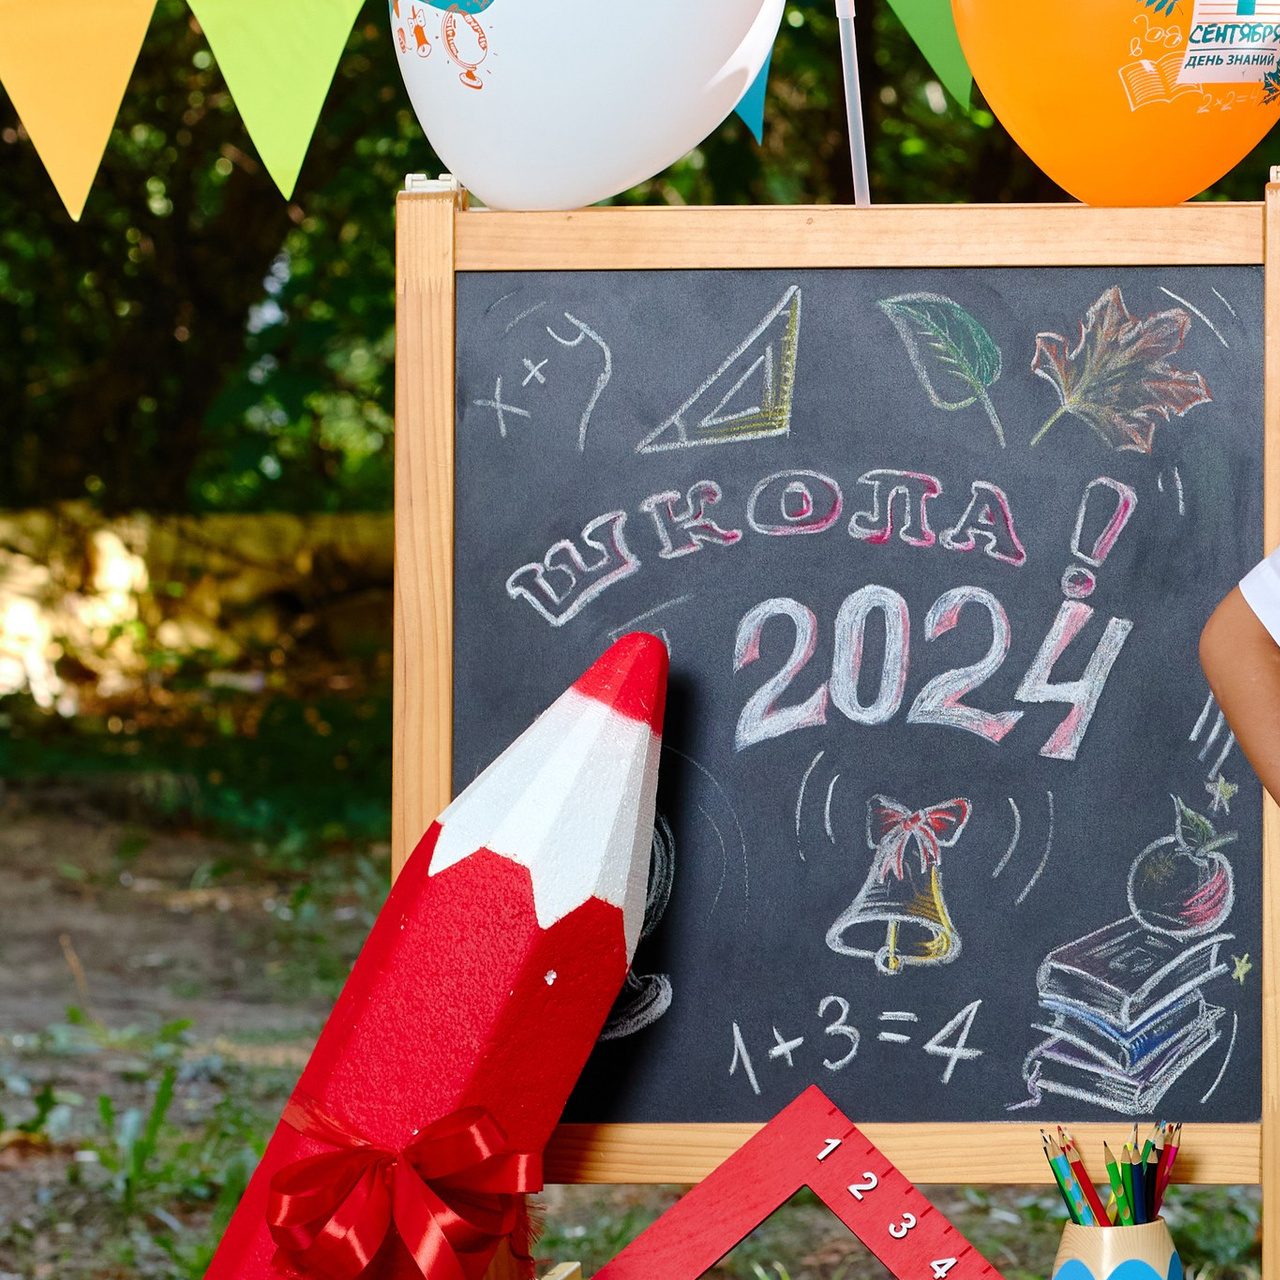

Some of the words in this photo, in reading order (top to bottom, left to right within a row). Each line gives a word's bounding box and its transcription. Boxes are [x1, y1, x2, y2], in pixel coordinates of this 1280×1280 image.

[1184, 54, 1224, 70] ДЕНЬ
[1226, 52, 1276, 67] ЗНАНИЙ
[732, 583, 1134, 761] 2024
[816, 1138, 842, 1162] 1
[847, 1172, 878, 1201] 2
[888, 1213, 917, 1238] 3
[929, 1257, 958, 1280] 4
